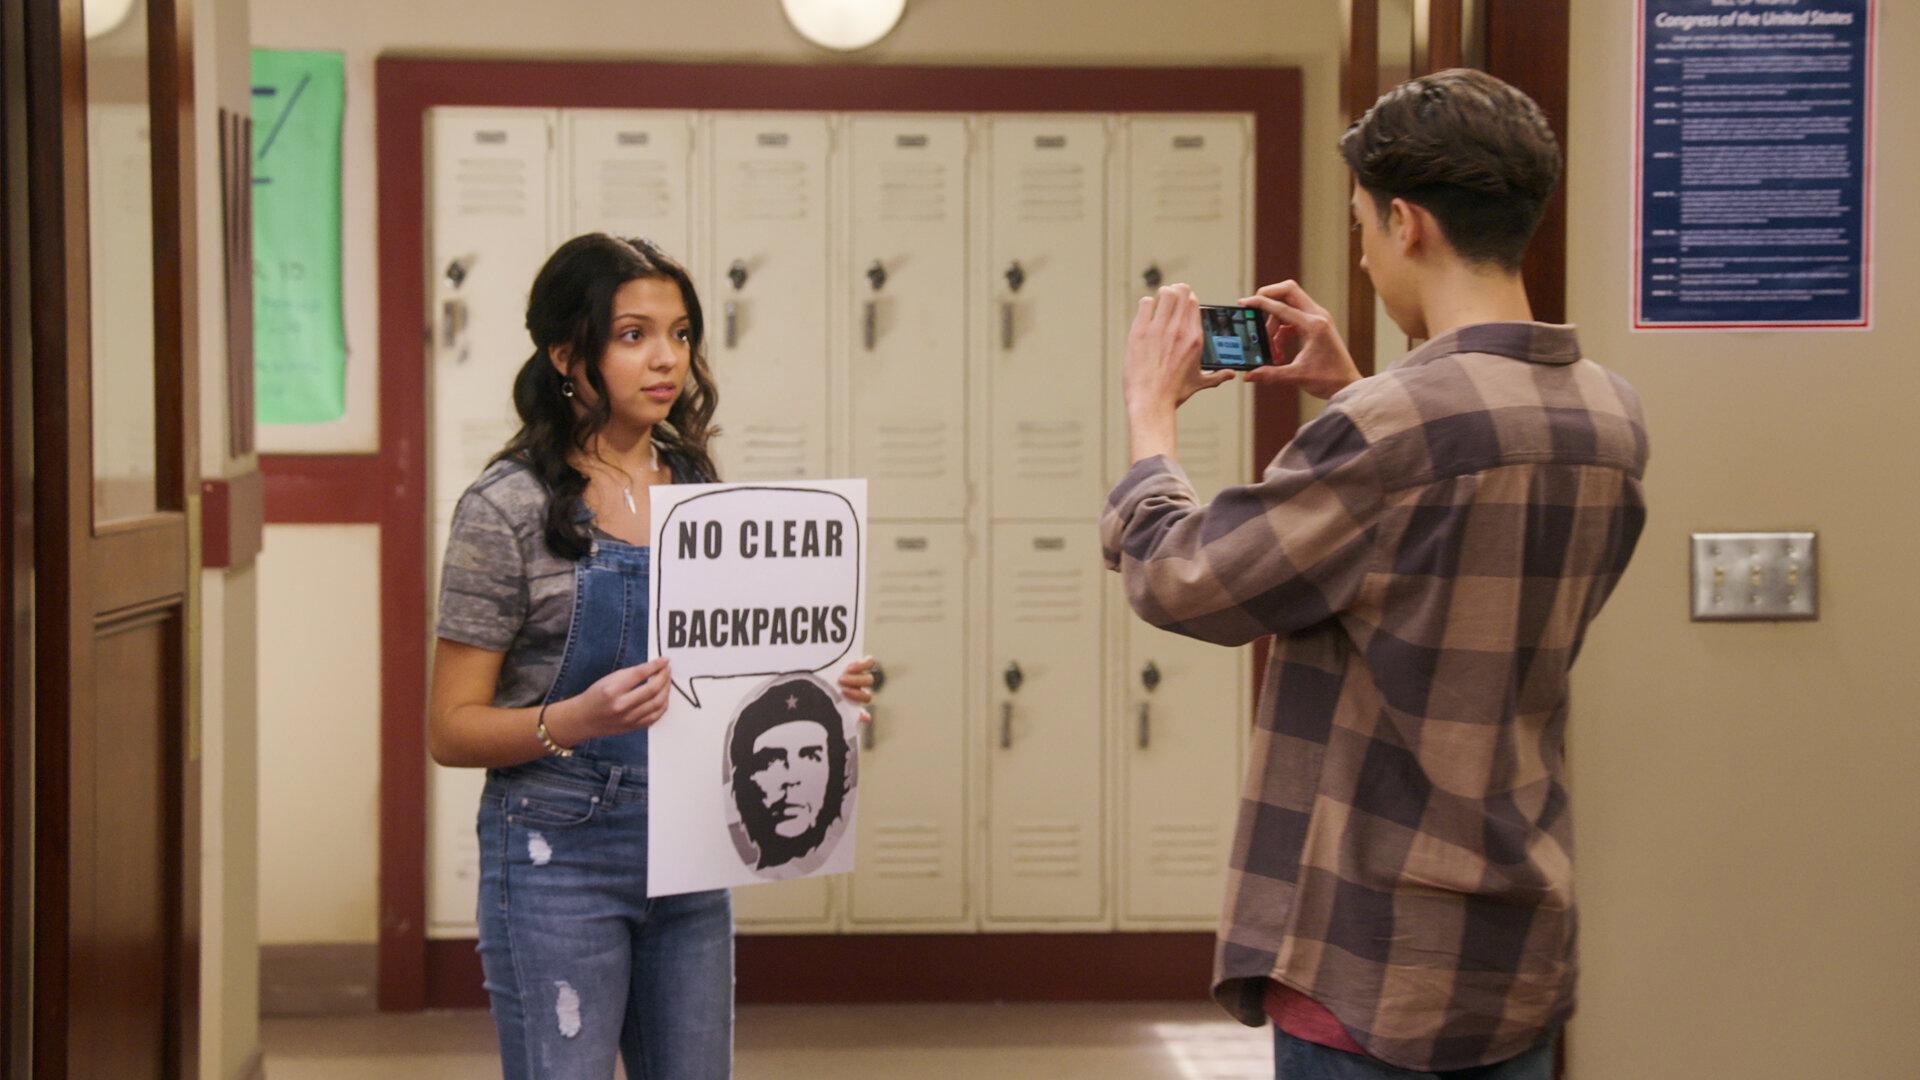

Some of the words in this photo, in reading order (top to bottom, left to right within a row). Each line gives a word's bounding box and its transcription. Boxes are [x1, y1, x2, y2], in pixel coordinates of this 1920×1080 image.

[1655, 12, 1719, 30] Congress
[1720, 11, 1738, 26] of
[1738, 11, 1760, 26] the
[1762, 11, 1810, 25] United
[1810, 10, 1853, 25] States
[678, 520, 722, 559] NO
[739, 520, 843, 559] CLEAR
[667, 605, 847, 648] BACKPACKS
